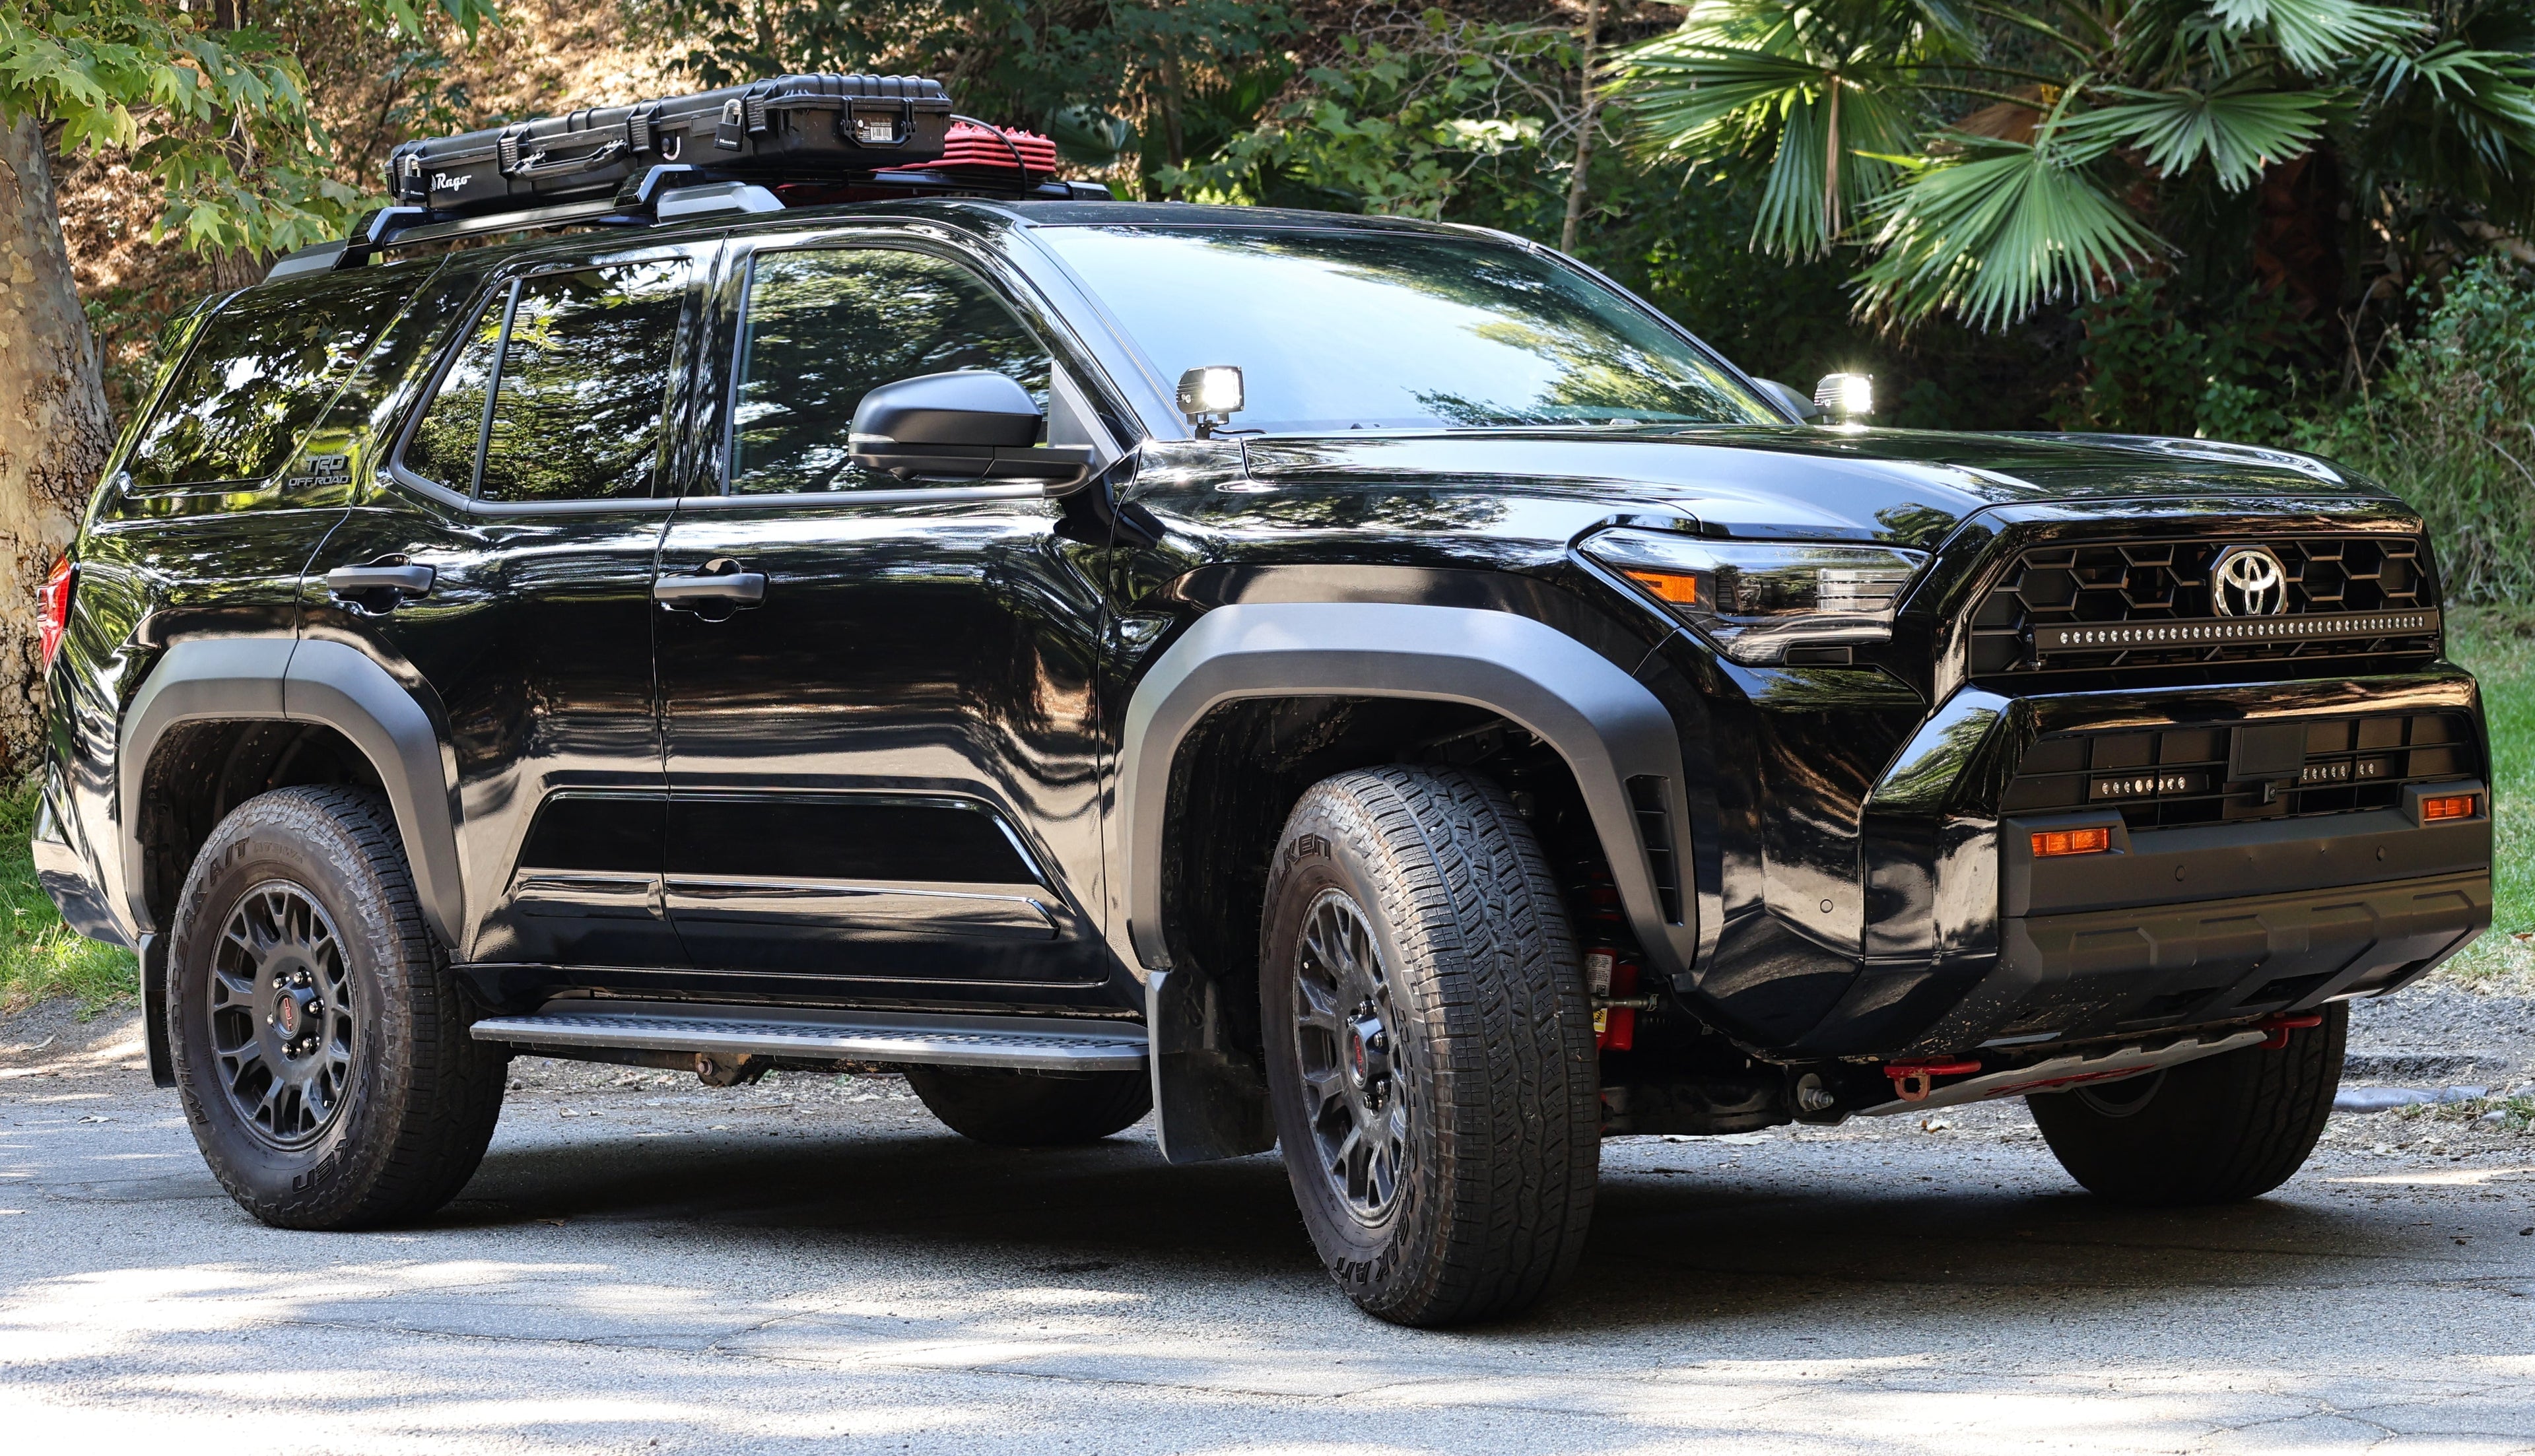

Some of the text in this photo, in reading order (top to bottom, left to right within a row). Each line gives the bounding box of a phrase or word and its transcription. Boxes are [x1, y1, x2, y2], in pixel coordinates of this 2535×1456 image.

[435, 172, 472, 191] Rago
[305, 453, 349, 476] TRD
[288, 476, 352, 487] OFF ROAD
[171, 876, 211, 1125] WILDPEAK
[209, 836, 250, 885] A/T
[283, 997, 293, 1031] TRD
[1353, 1034, 1364, 1077] TRD
[1333, 1255, 1372, 1286] A/T
